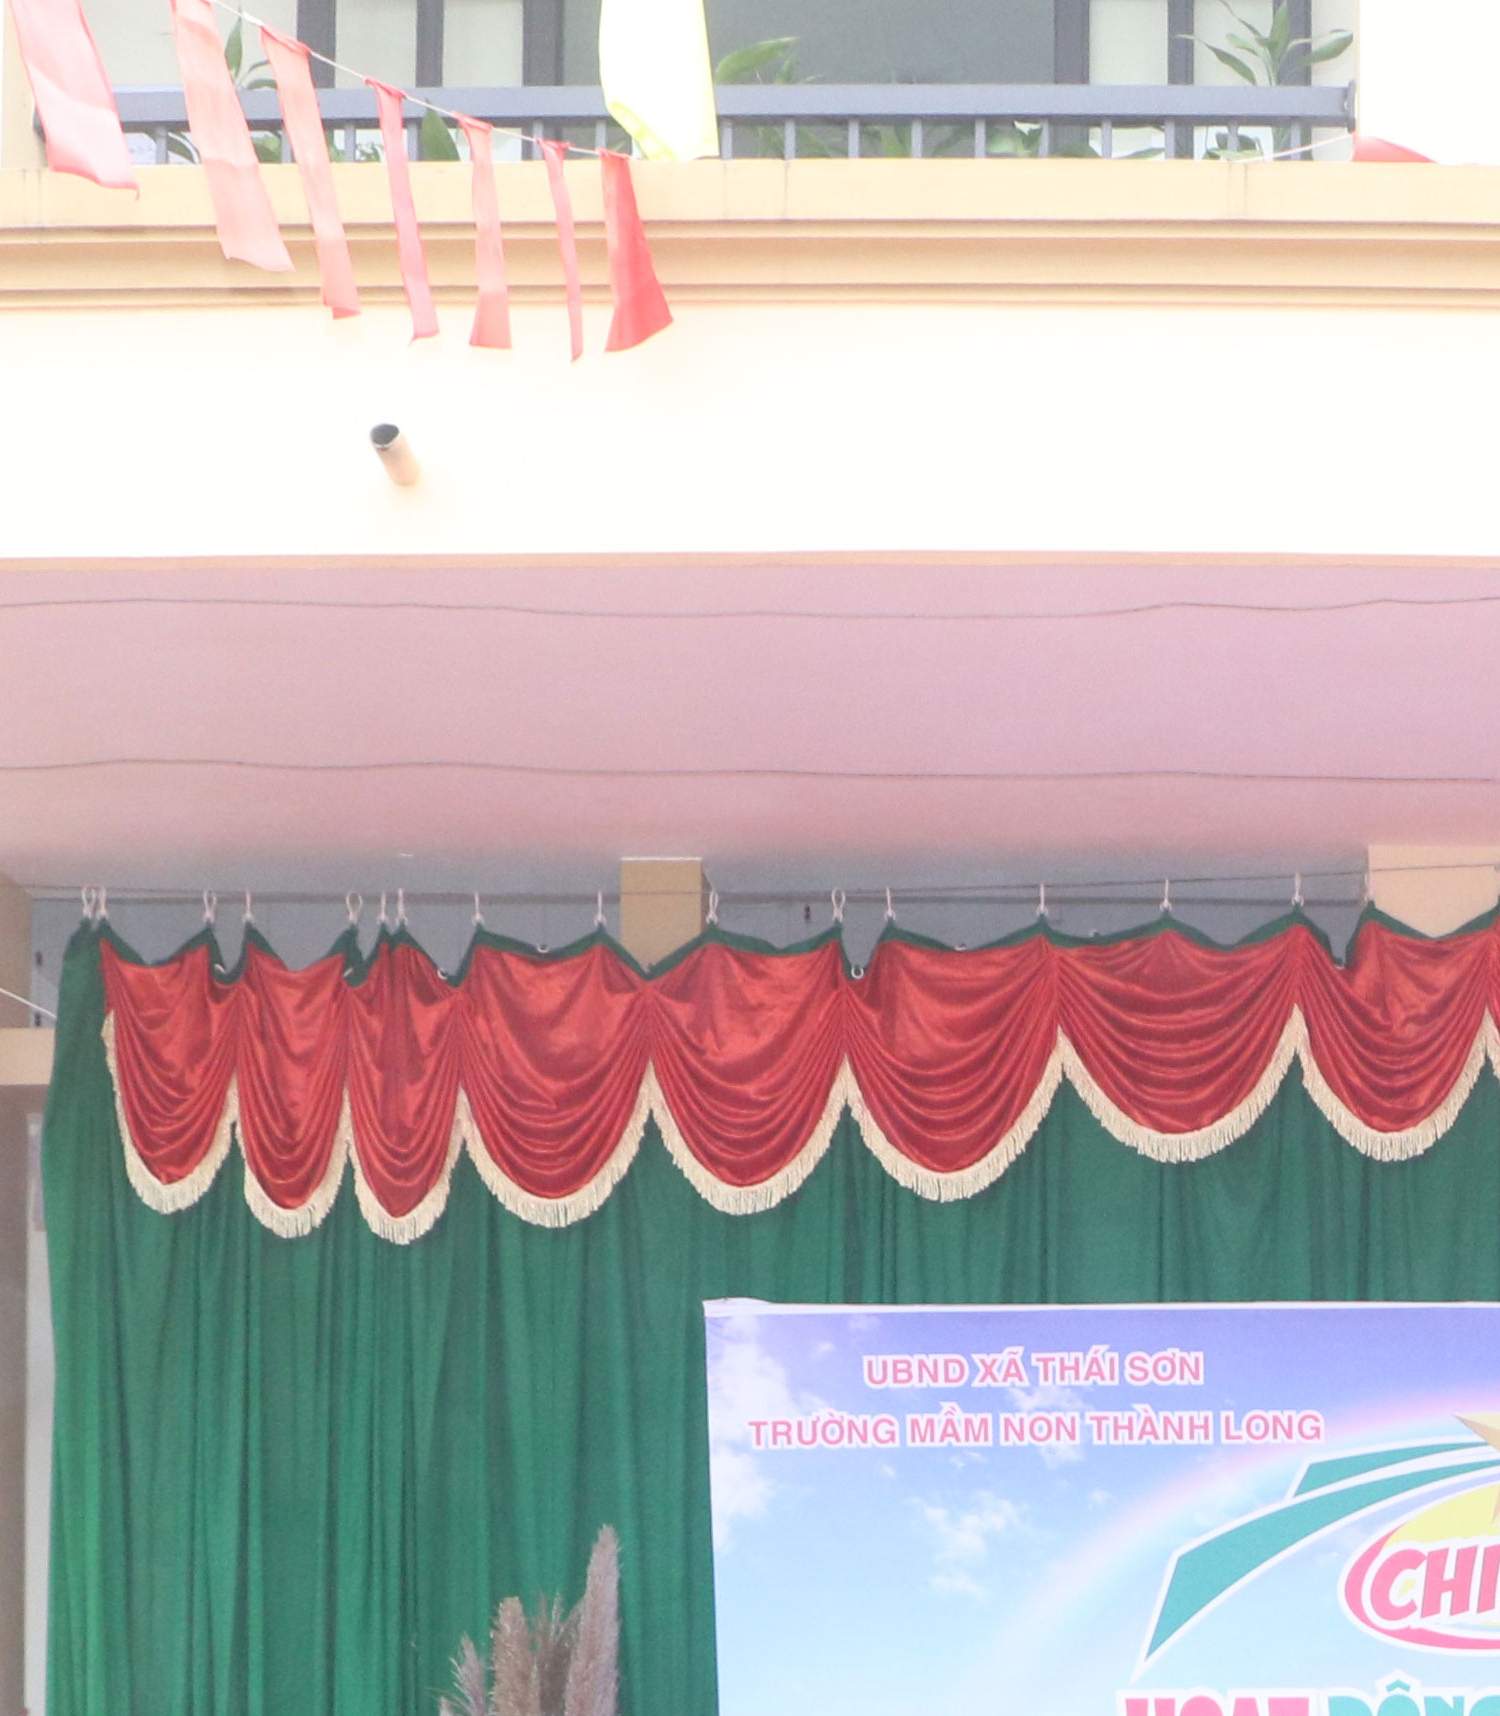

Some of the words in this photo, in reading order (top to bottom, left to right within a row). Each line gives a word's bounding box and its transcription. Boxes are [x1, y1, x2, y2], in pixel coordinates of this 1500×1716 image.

[866, 1356, 967, 1386] UBND
[978, 1347, 1028, 1385] XÃ
[1036, 1345, 1117, 1383] THÁI
[1126, 1350, 1203, 1383] SƠN
[749, 1412, 898, 1447] TRƯỜNG
[910, 1401, 990, 1445] MẦM
[1003, 1415, 1078, 1443] NON
[1090, 1404, 1210, 1442] THÀNH
[1224, 1411, 1324, 1440] LONG
